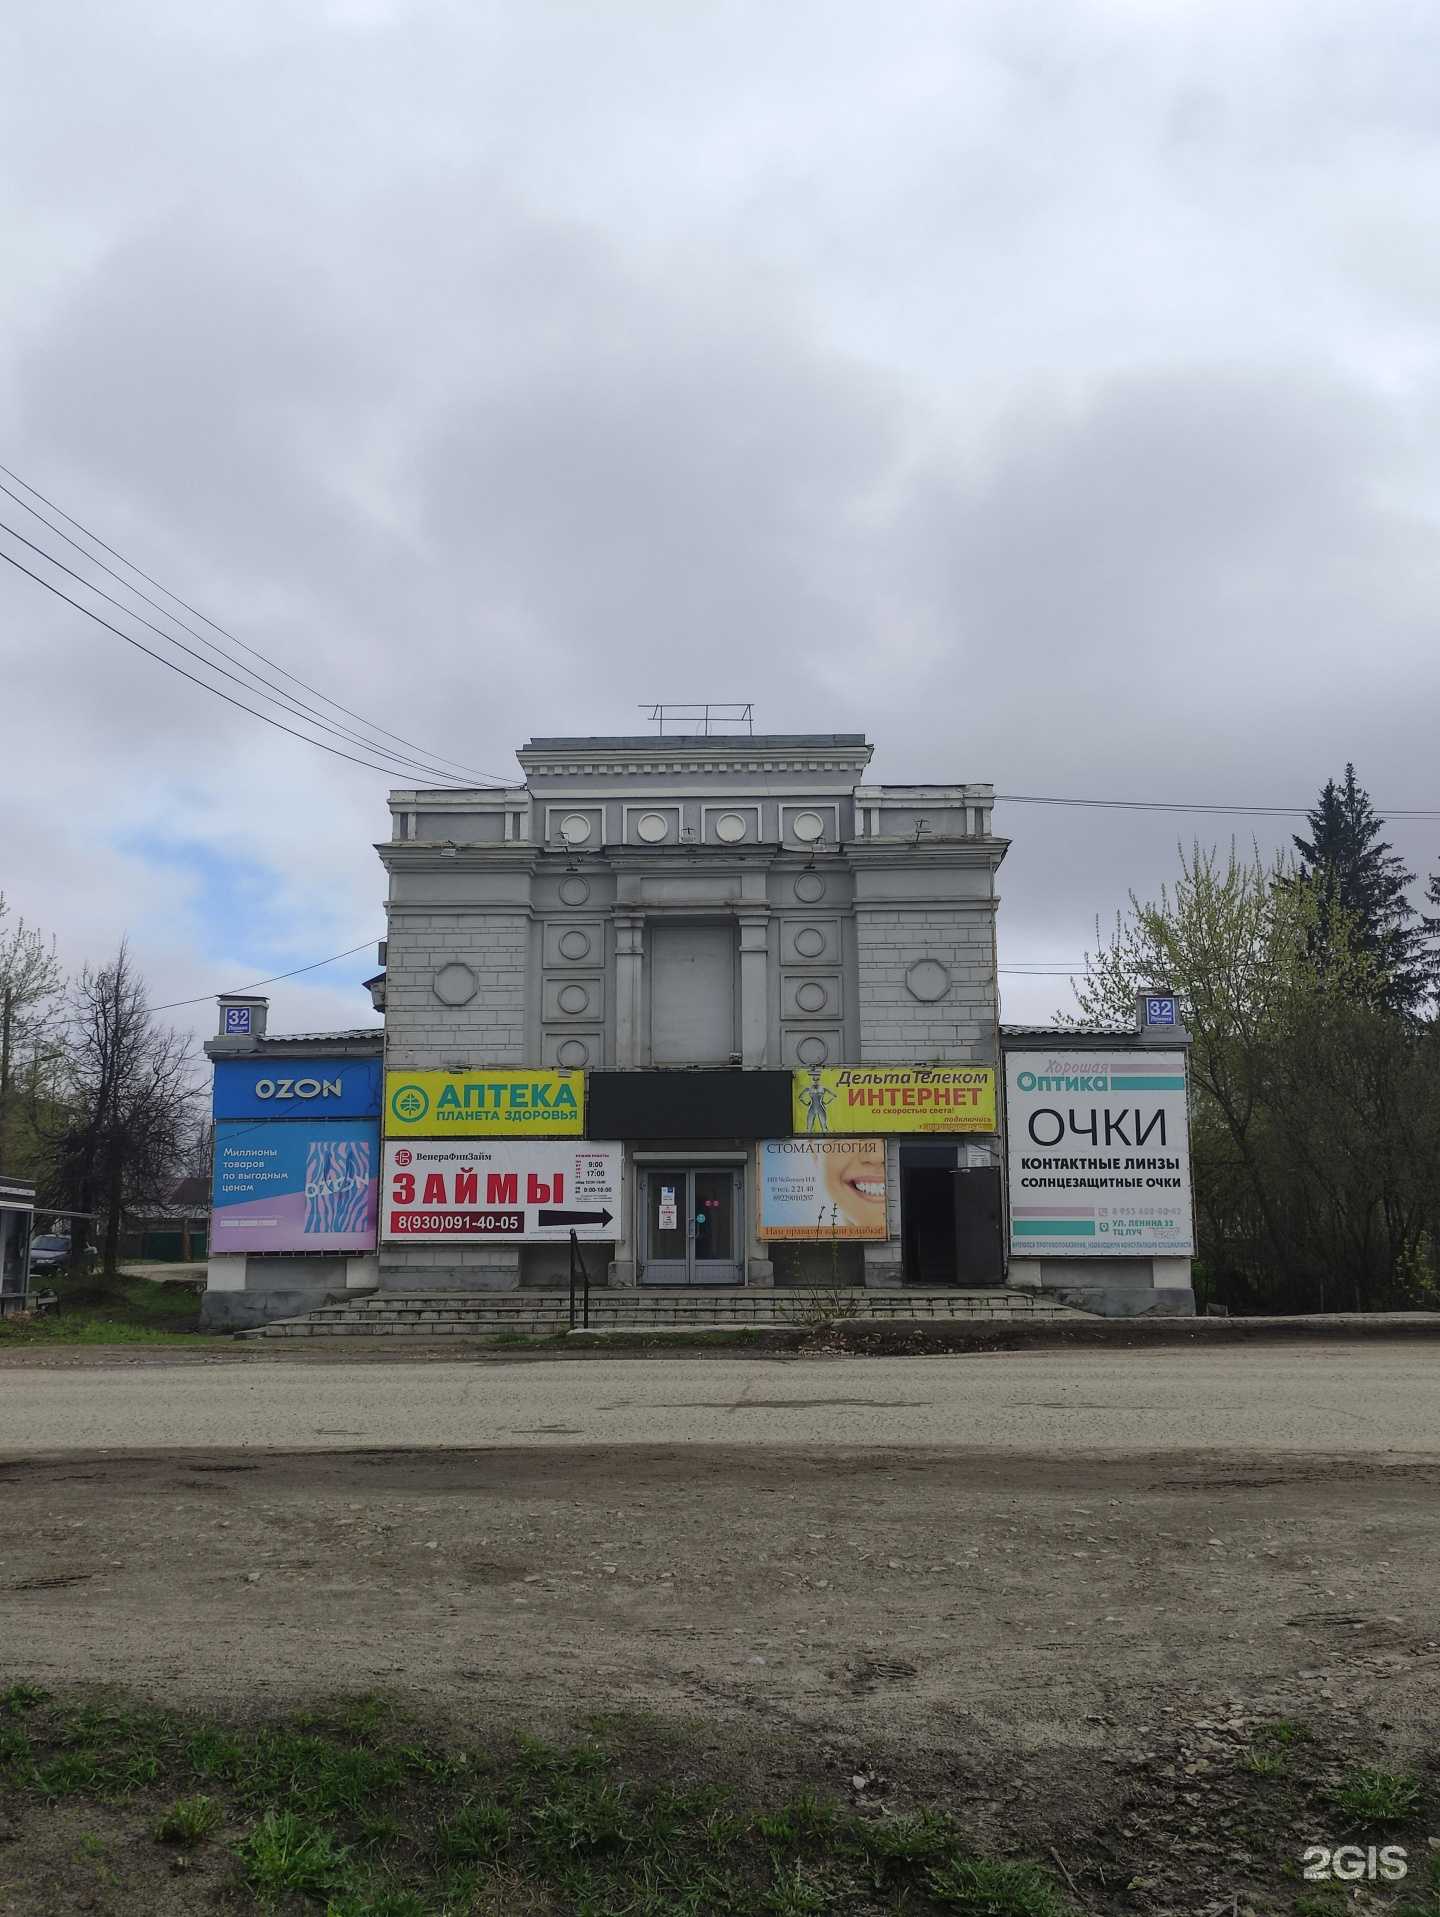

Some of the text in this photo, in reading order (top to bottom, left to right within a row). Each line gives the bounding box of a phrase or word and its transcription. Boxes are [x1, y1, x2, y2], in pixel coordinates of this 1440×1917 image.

[1150, 1001, 1172, 1016] 32
[228, 1010, 249, 1025] 32
[1044, 1060, 1108, 1075] Хорошая
[255, 1078, 342, 1099] OZON
[1017, 1071, 1108, 1092] Оптика
[436, 1083, 577, 1108] АПТЕКА
[848, 1088, 982, 1106] ИНТЕРНЕТ
[436, 1110, 577, 1122] ПЛАНЕТА ЗДОРОВЬЯ
[1028, 1108, 1166, 1146] ОЧКИ
[223, 1148, 278, 1157] Миллионы
[767, 1143, 876, 1154] СТОМАТОЛОГИЯ
[416, 1152, 492, 1162] ВенераФинЗайм
[1021, 1158, 1180, 1170] КОНТАКТНЫЕ ЛИНЗЫ
[223, 1161, 265, 1170] товаров
[238, 1172, 289, 1181] выгодным
[1021, 1177, 1181, 1189] СОЛНЦЕЗАЩИТНЫЕ ОЧКИ
[222, 1184, 255, 1193] ценам
[392, 1167, 564, 1204] ЗАЙМЫ
[398, 1215, 518, 1232] 8(930)091-40-05
